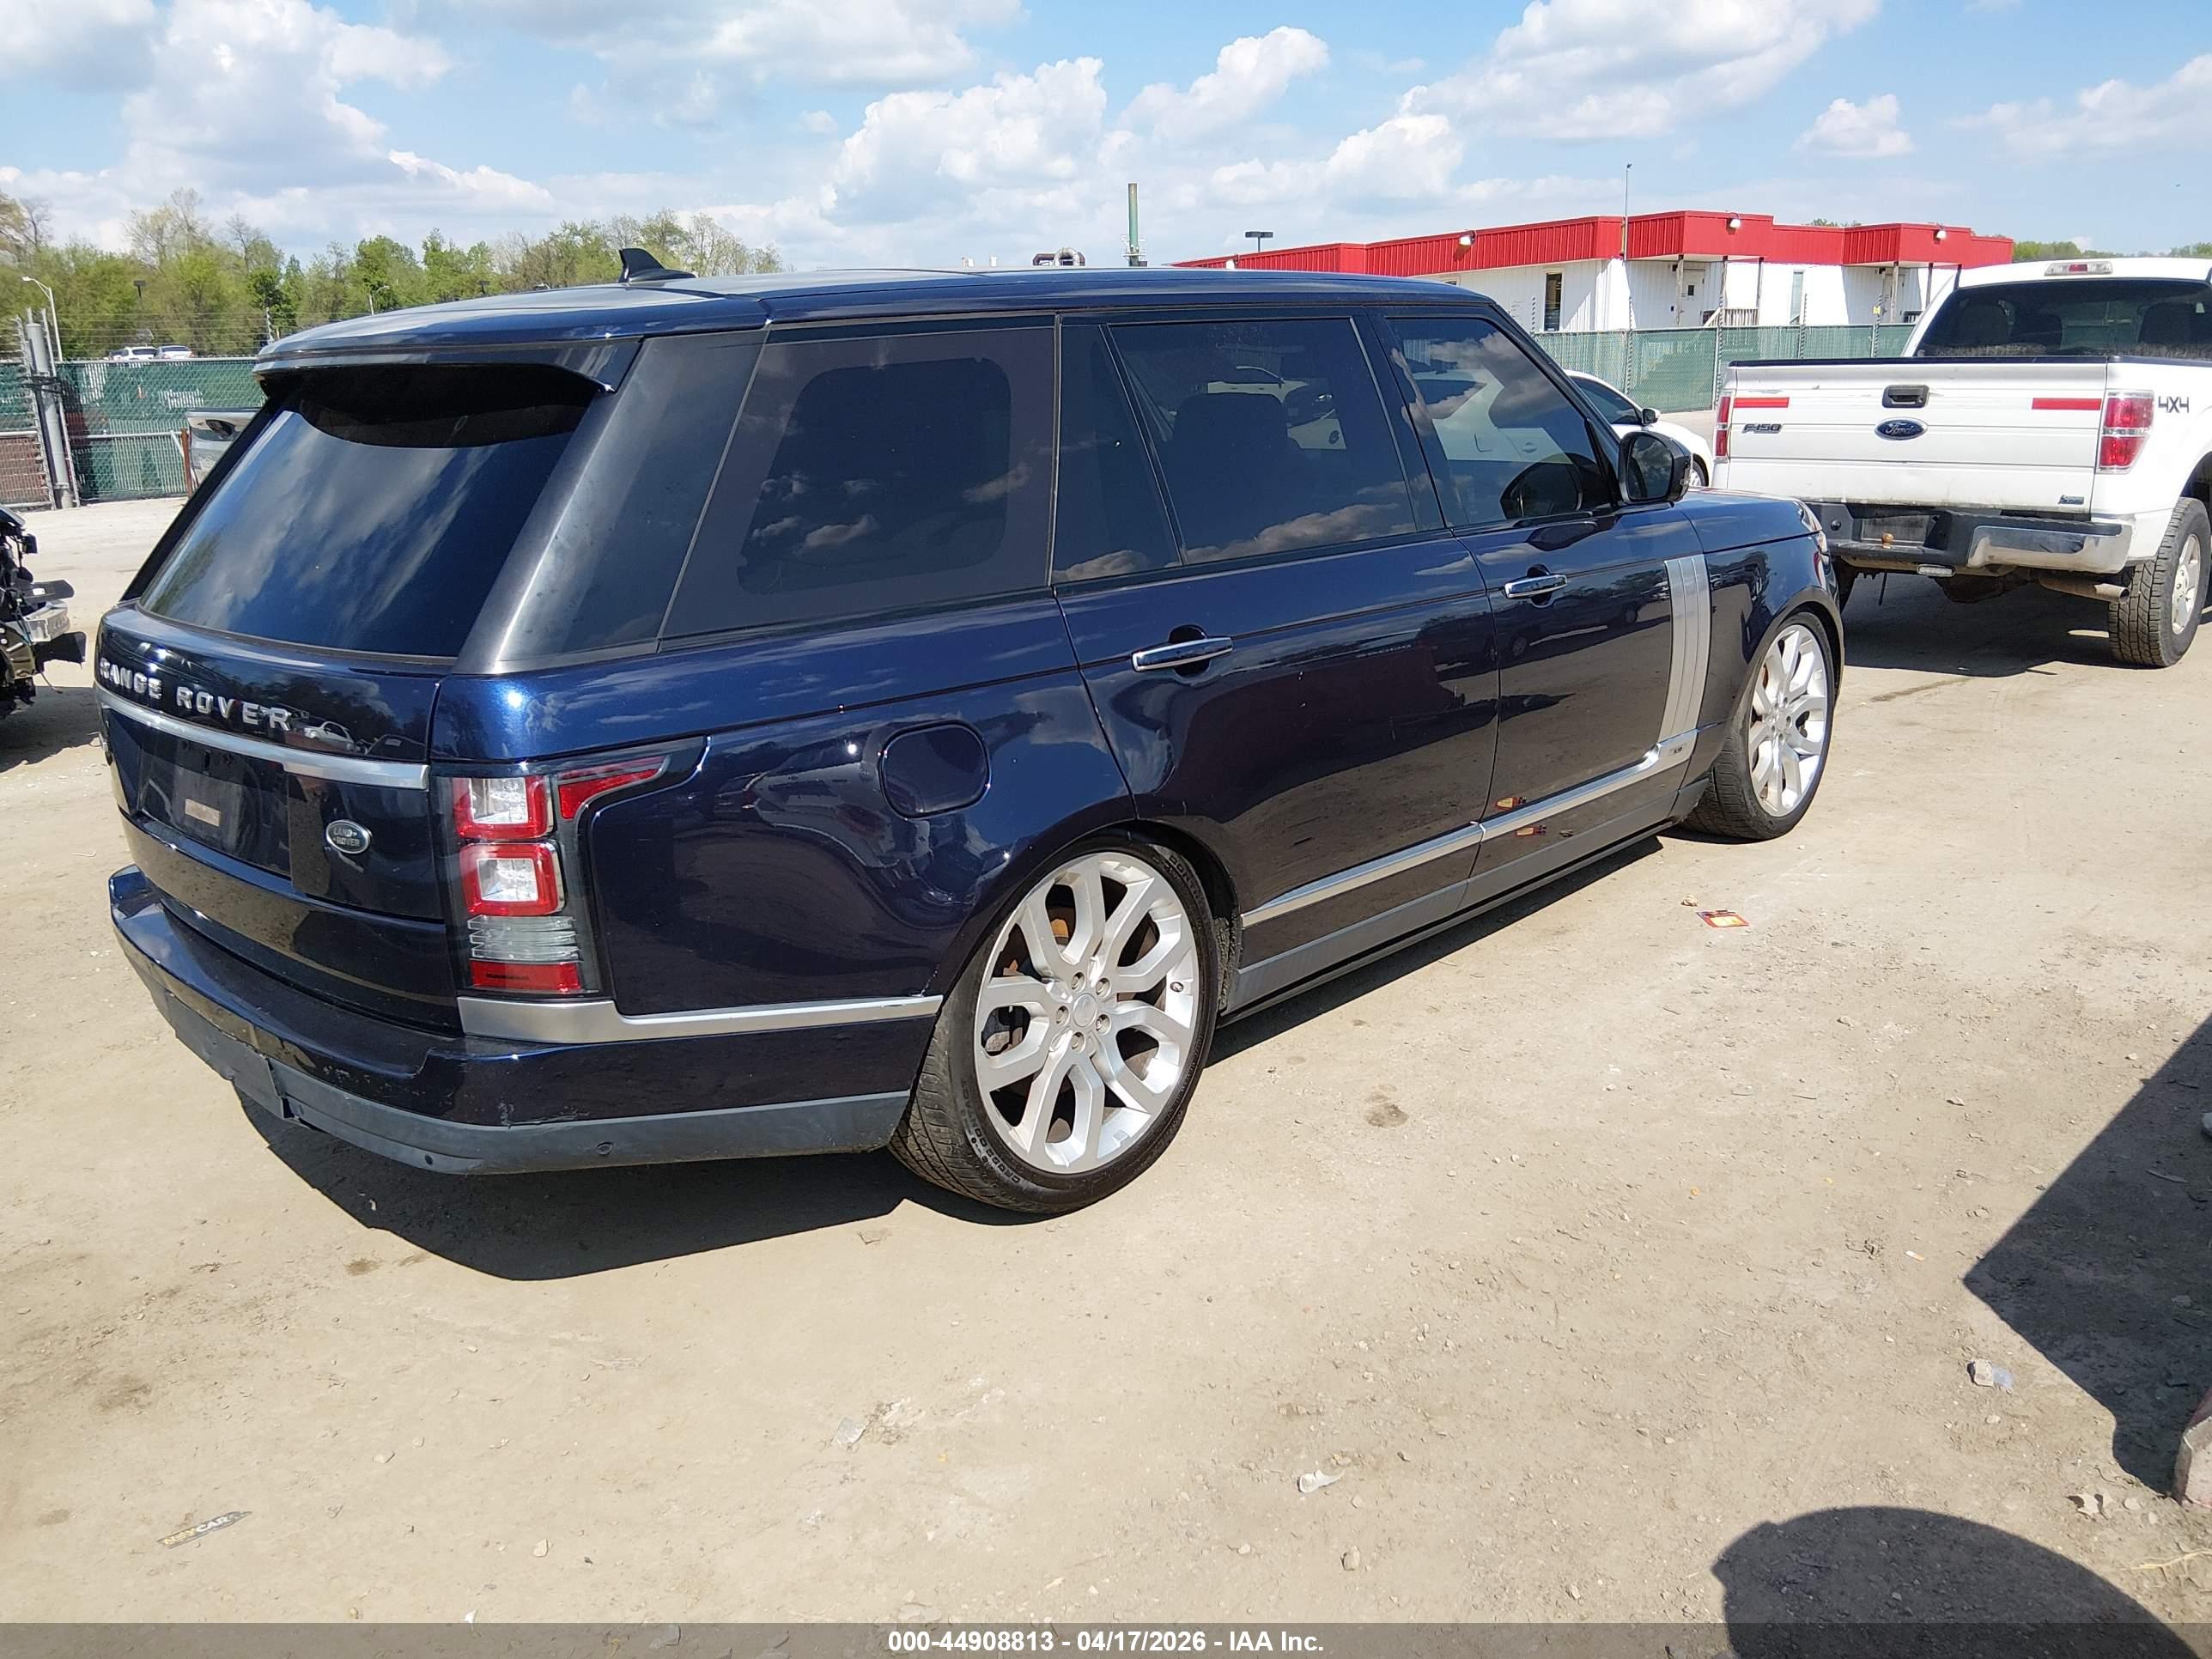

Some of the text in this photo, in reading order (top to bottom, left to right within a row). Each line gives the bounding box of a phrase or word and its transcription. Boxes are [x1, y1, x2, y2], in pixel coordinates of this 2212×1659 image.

[2158, 396, 2190, 413] 4X4
[100, 657, 291, 732] RANGE ROVER
[336, 836, 361, 848] ROVER
